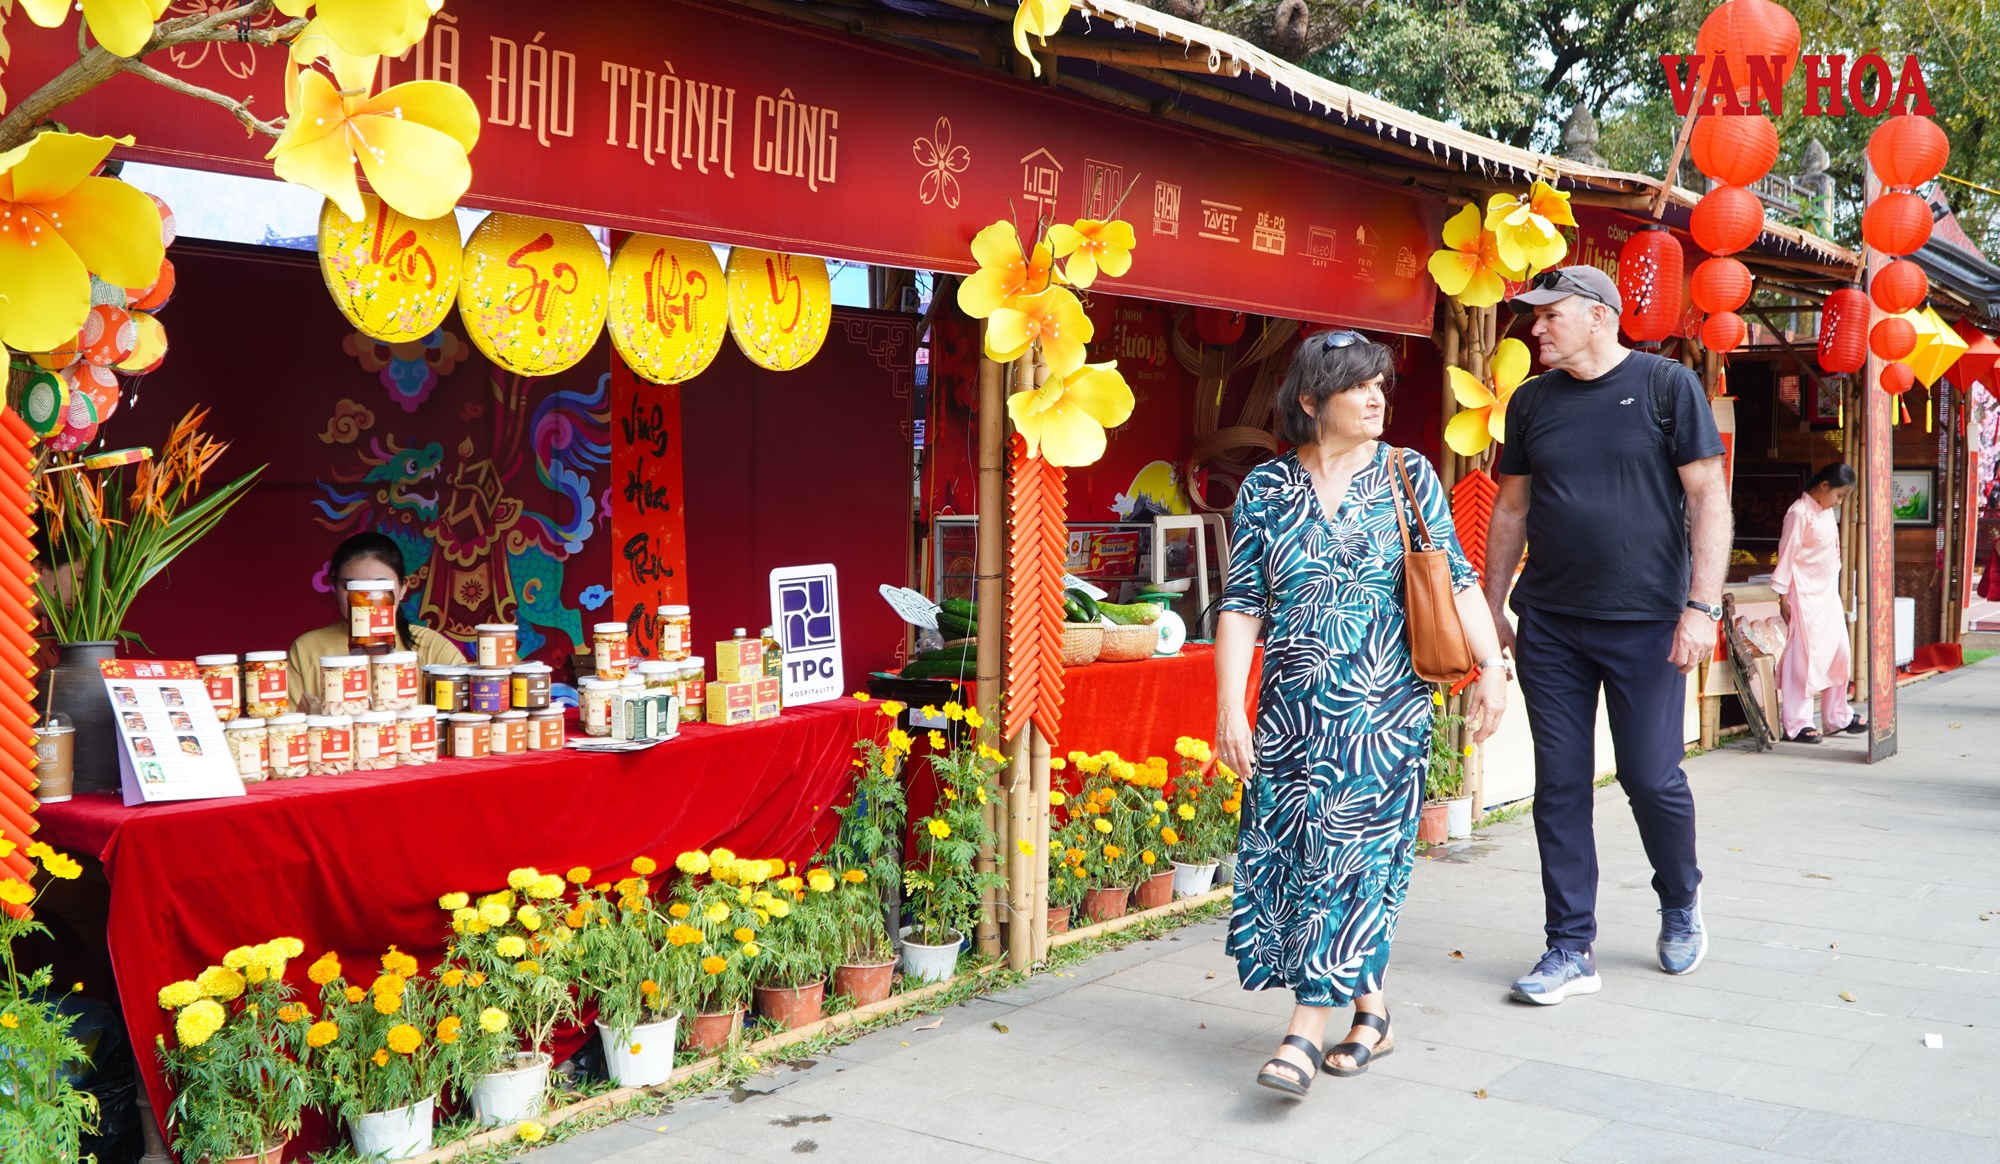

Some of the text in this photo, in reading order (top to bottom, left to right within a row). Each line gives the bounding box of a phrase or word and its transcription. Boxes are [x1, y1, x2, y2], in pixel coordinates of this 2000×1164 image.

[486, 31, 577, 148] ĐÁO
[600, 60, 736, 179] THÀNH
[752, 87, 839, 193] CÔNG
[787, 657, 834, 684] TPG
[789, 685, 835, 699] HOSPITALITY
